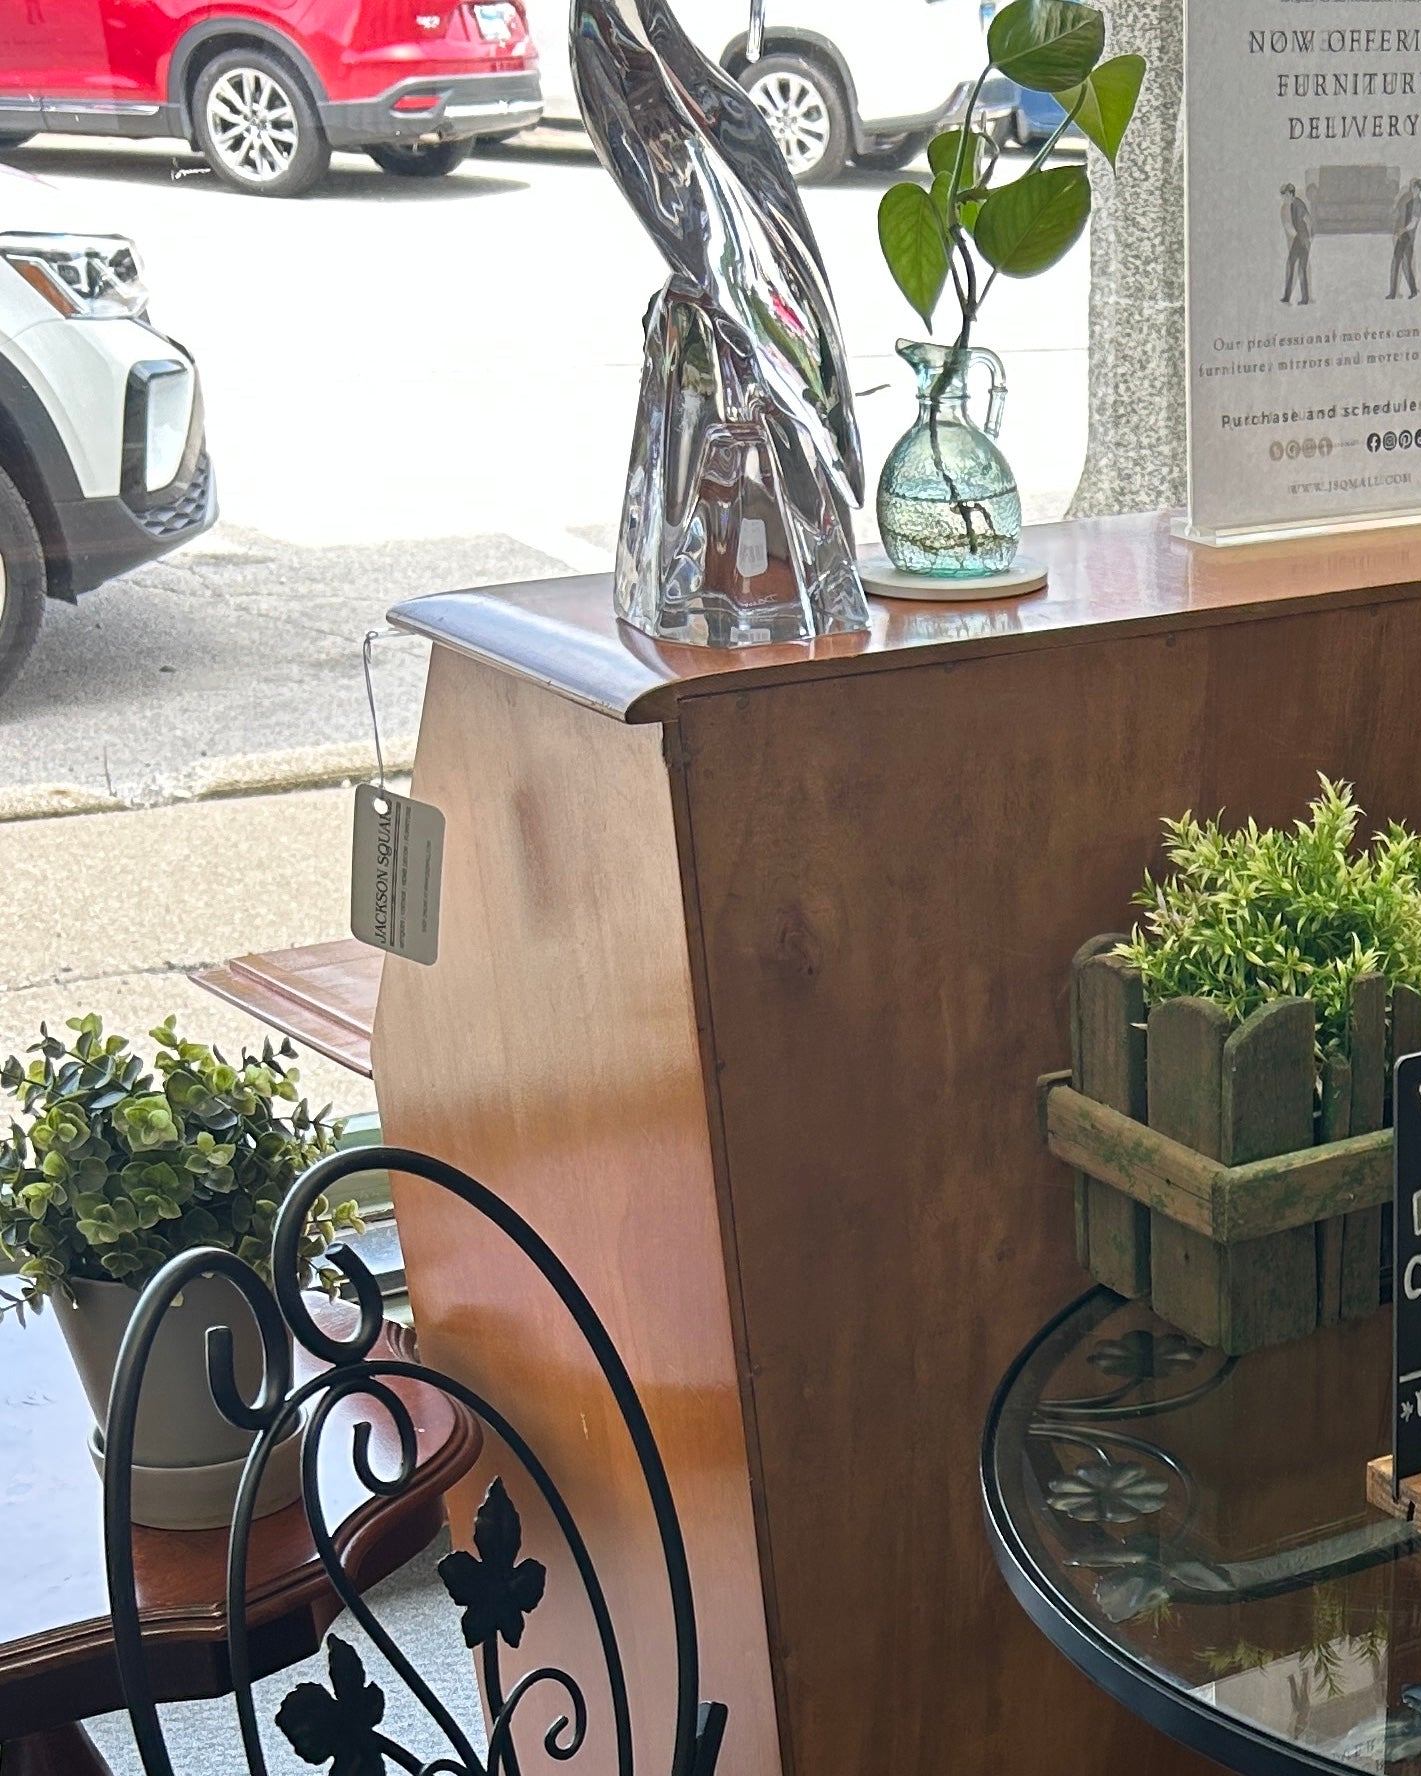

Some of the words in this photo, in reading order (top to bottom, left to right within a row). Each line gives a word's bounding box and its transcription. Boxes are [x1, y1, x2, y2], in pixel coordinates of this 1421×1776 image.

[1250, 29, 1315, 53] NOW
[1289, 114, 1419, 140] DELIVERY
[1213, 338, 1240, 351] Our
[1247, 330, 1337, 352] professional
[1342, 331, 1391, 342] movers
[1396, 328, 1420, 338] can
[1277, 358, 1330, 371] mirrors
[1336, 352, 1360, 366] and
[1367, 353, 1400, 364] more
[1405, 350, 1419, 361] to
[1221, 412, 1298, 429] Purchase
[1306, 405, 1336, 421] and
[1343, 400, 1417, 418] schedule
[375, 868, 390, 944] JACKSON
